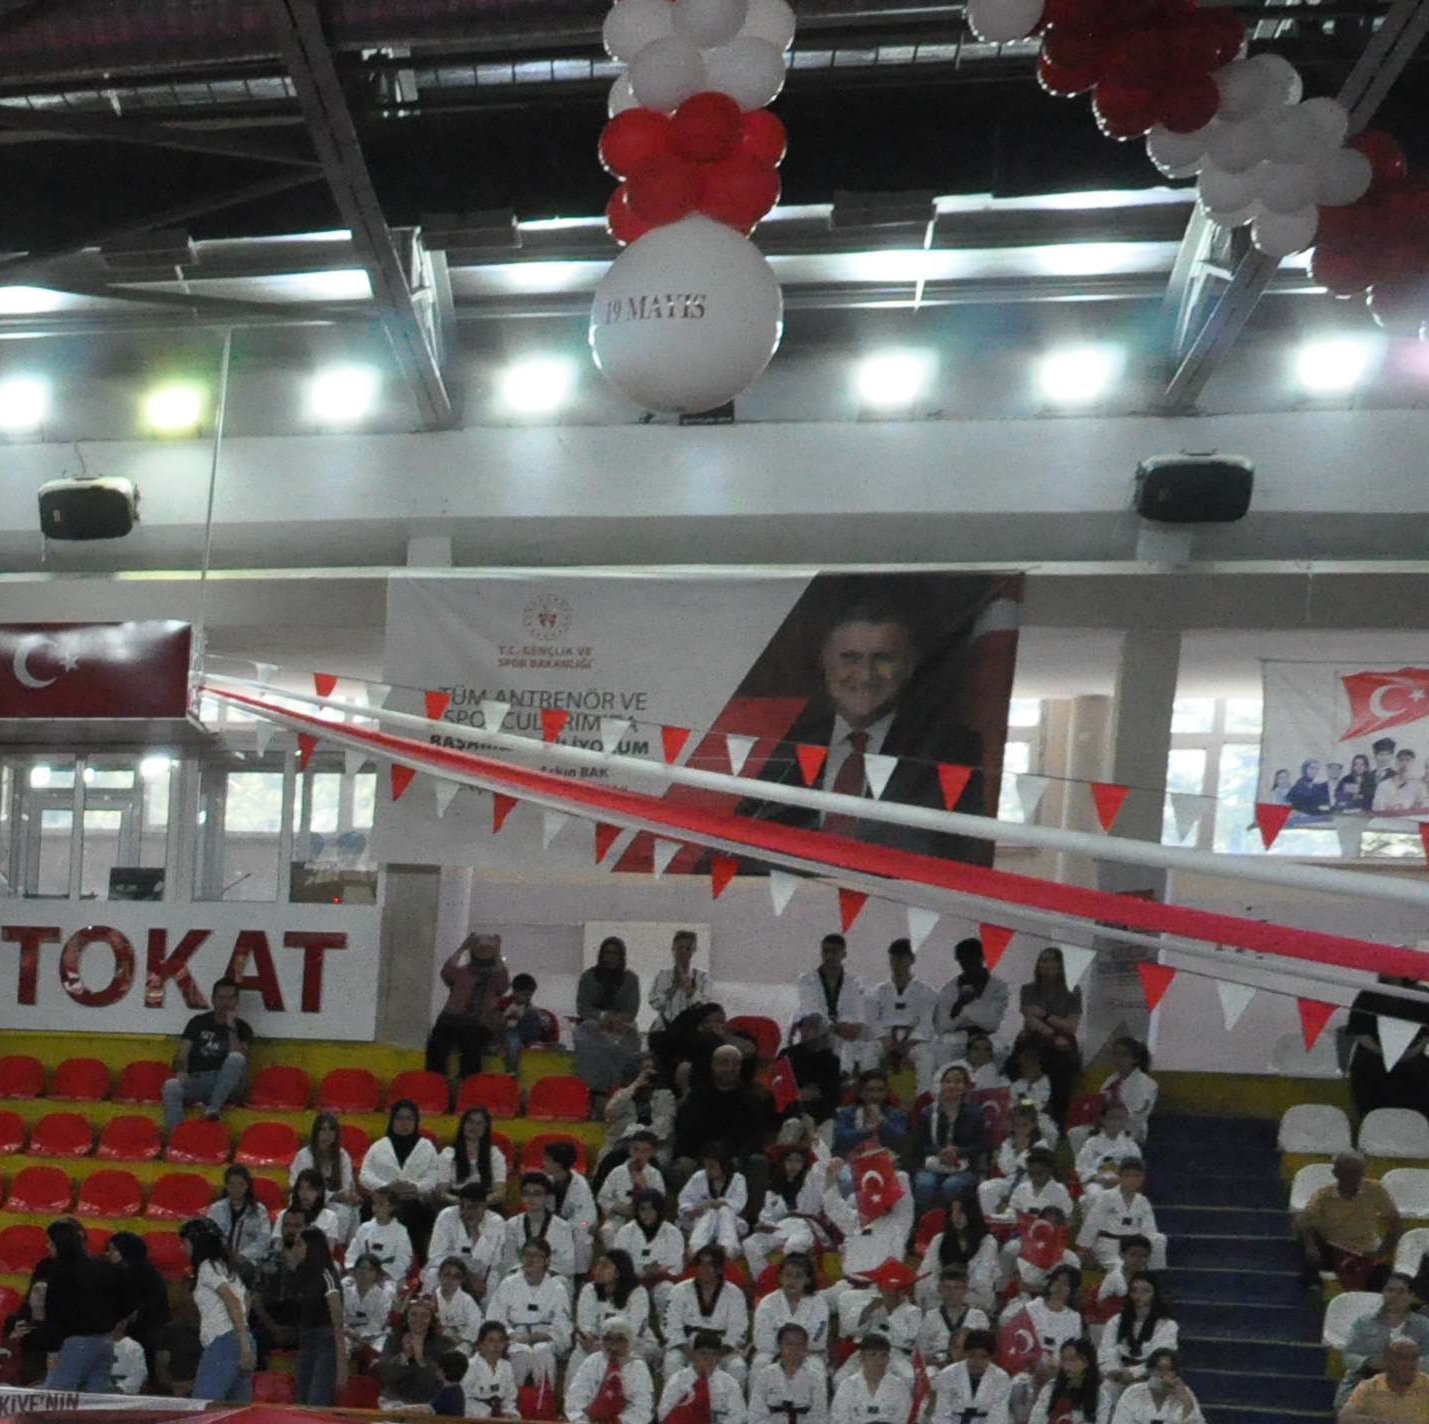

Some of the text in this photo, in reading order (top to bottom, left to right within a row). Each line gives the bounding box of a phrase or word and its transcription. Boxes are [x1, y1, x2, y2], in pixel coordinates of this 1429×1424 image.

[627, 293, 707, 321] MAYIS
[497, 659, 527, 668] SPOR
[522, 646, 574, 659] GENÇLİK
[577, 647, 592, 657] VE
[495, 688, 613, 711] ANTRENÖR
[621, 692, 648, 711] VE
[0, 924, 348, 1013] TOKAT
